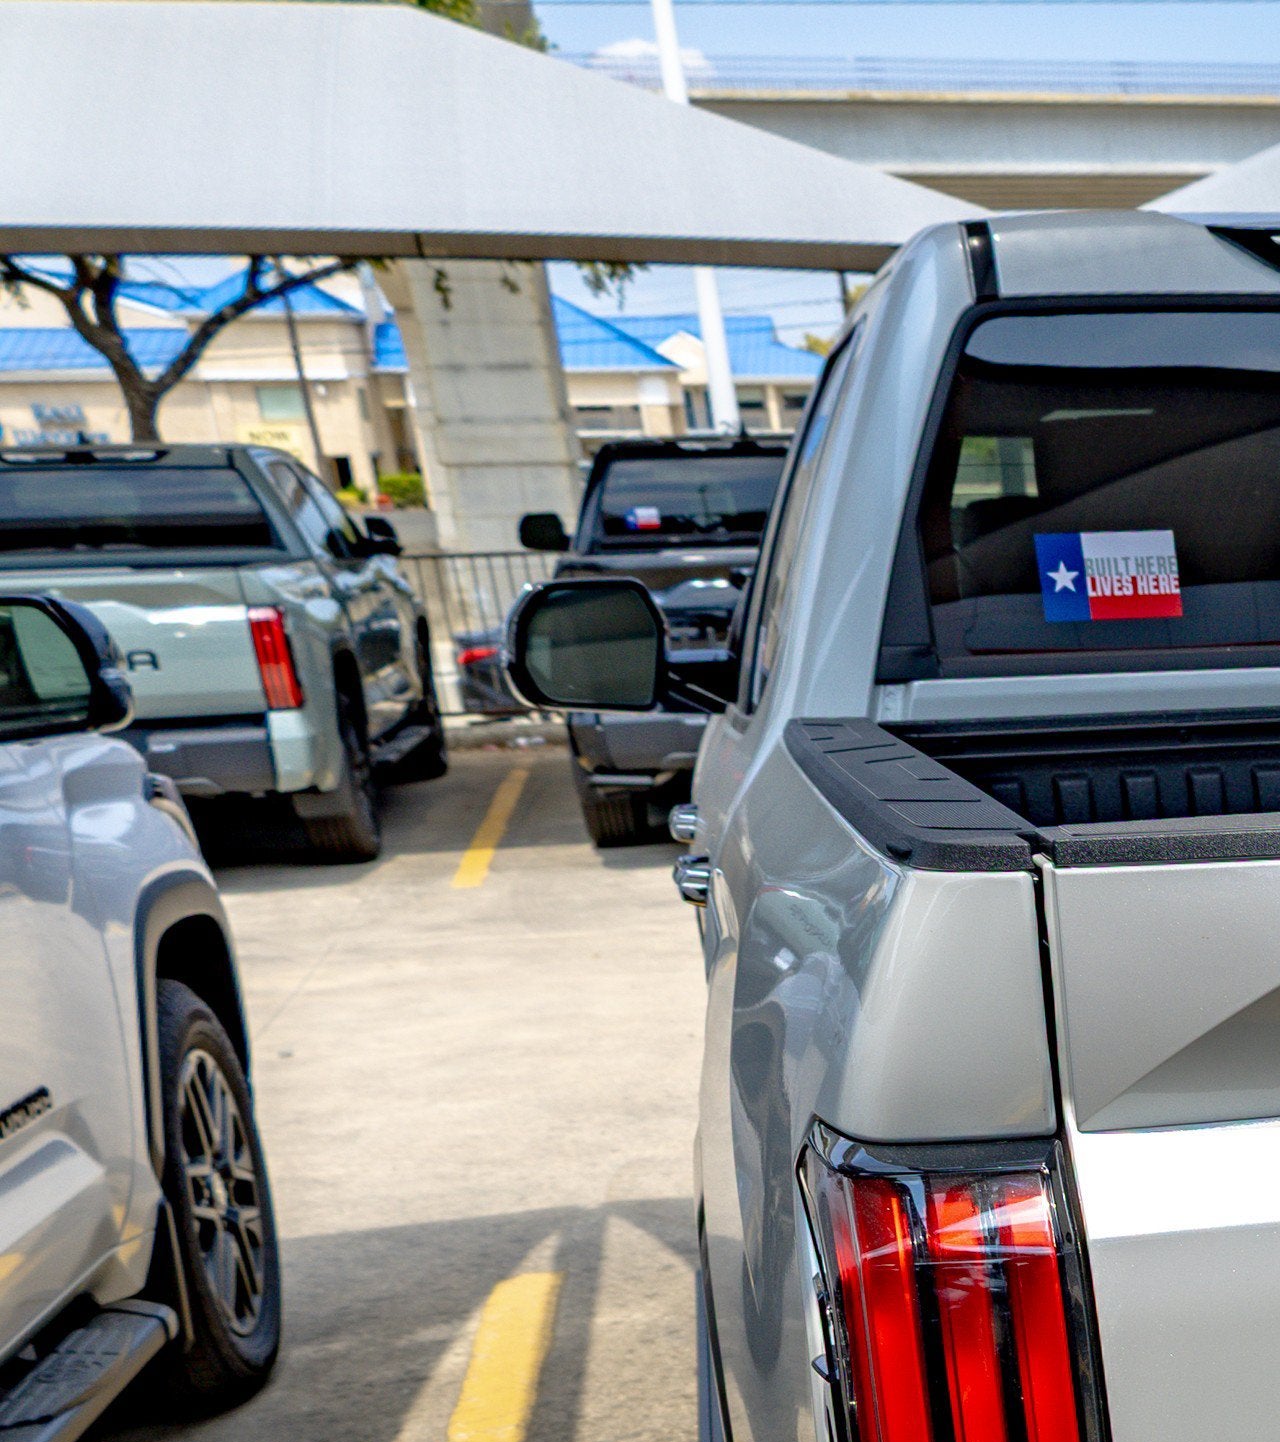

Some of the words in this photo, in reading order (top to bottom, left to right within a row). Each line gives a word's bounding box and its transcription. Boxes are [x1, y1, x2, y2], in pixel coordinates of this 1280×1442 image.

[1084, 556, 1131, 577] BUILT
[1134, 555, 1179, 576] HERE
[1086, 575, 1134, 597] LIVES
[1136, 574, 1181, 596] HERE
